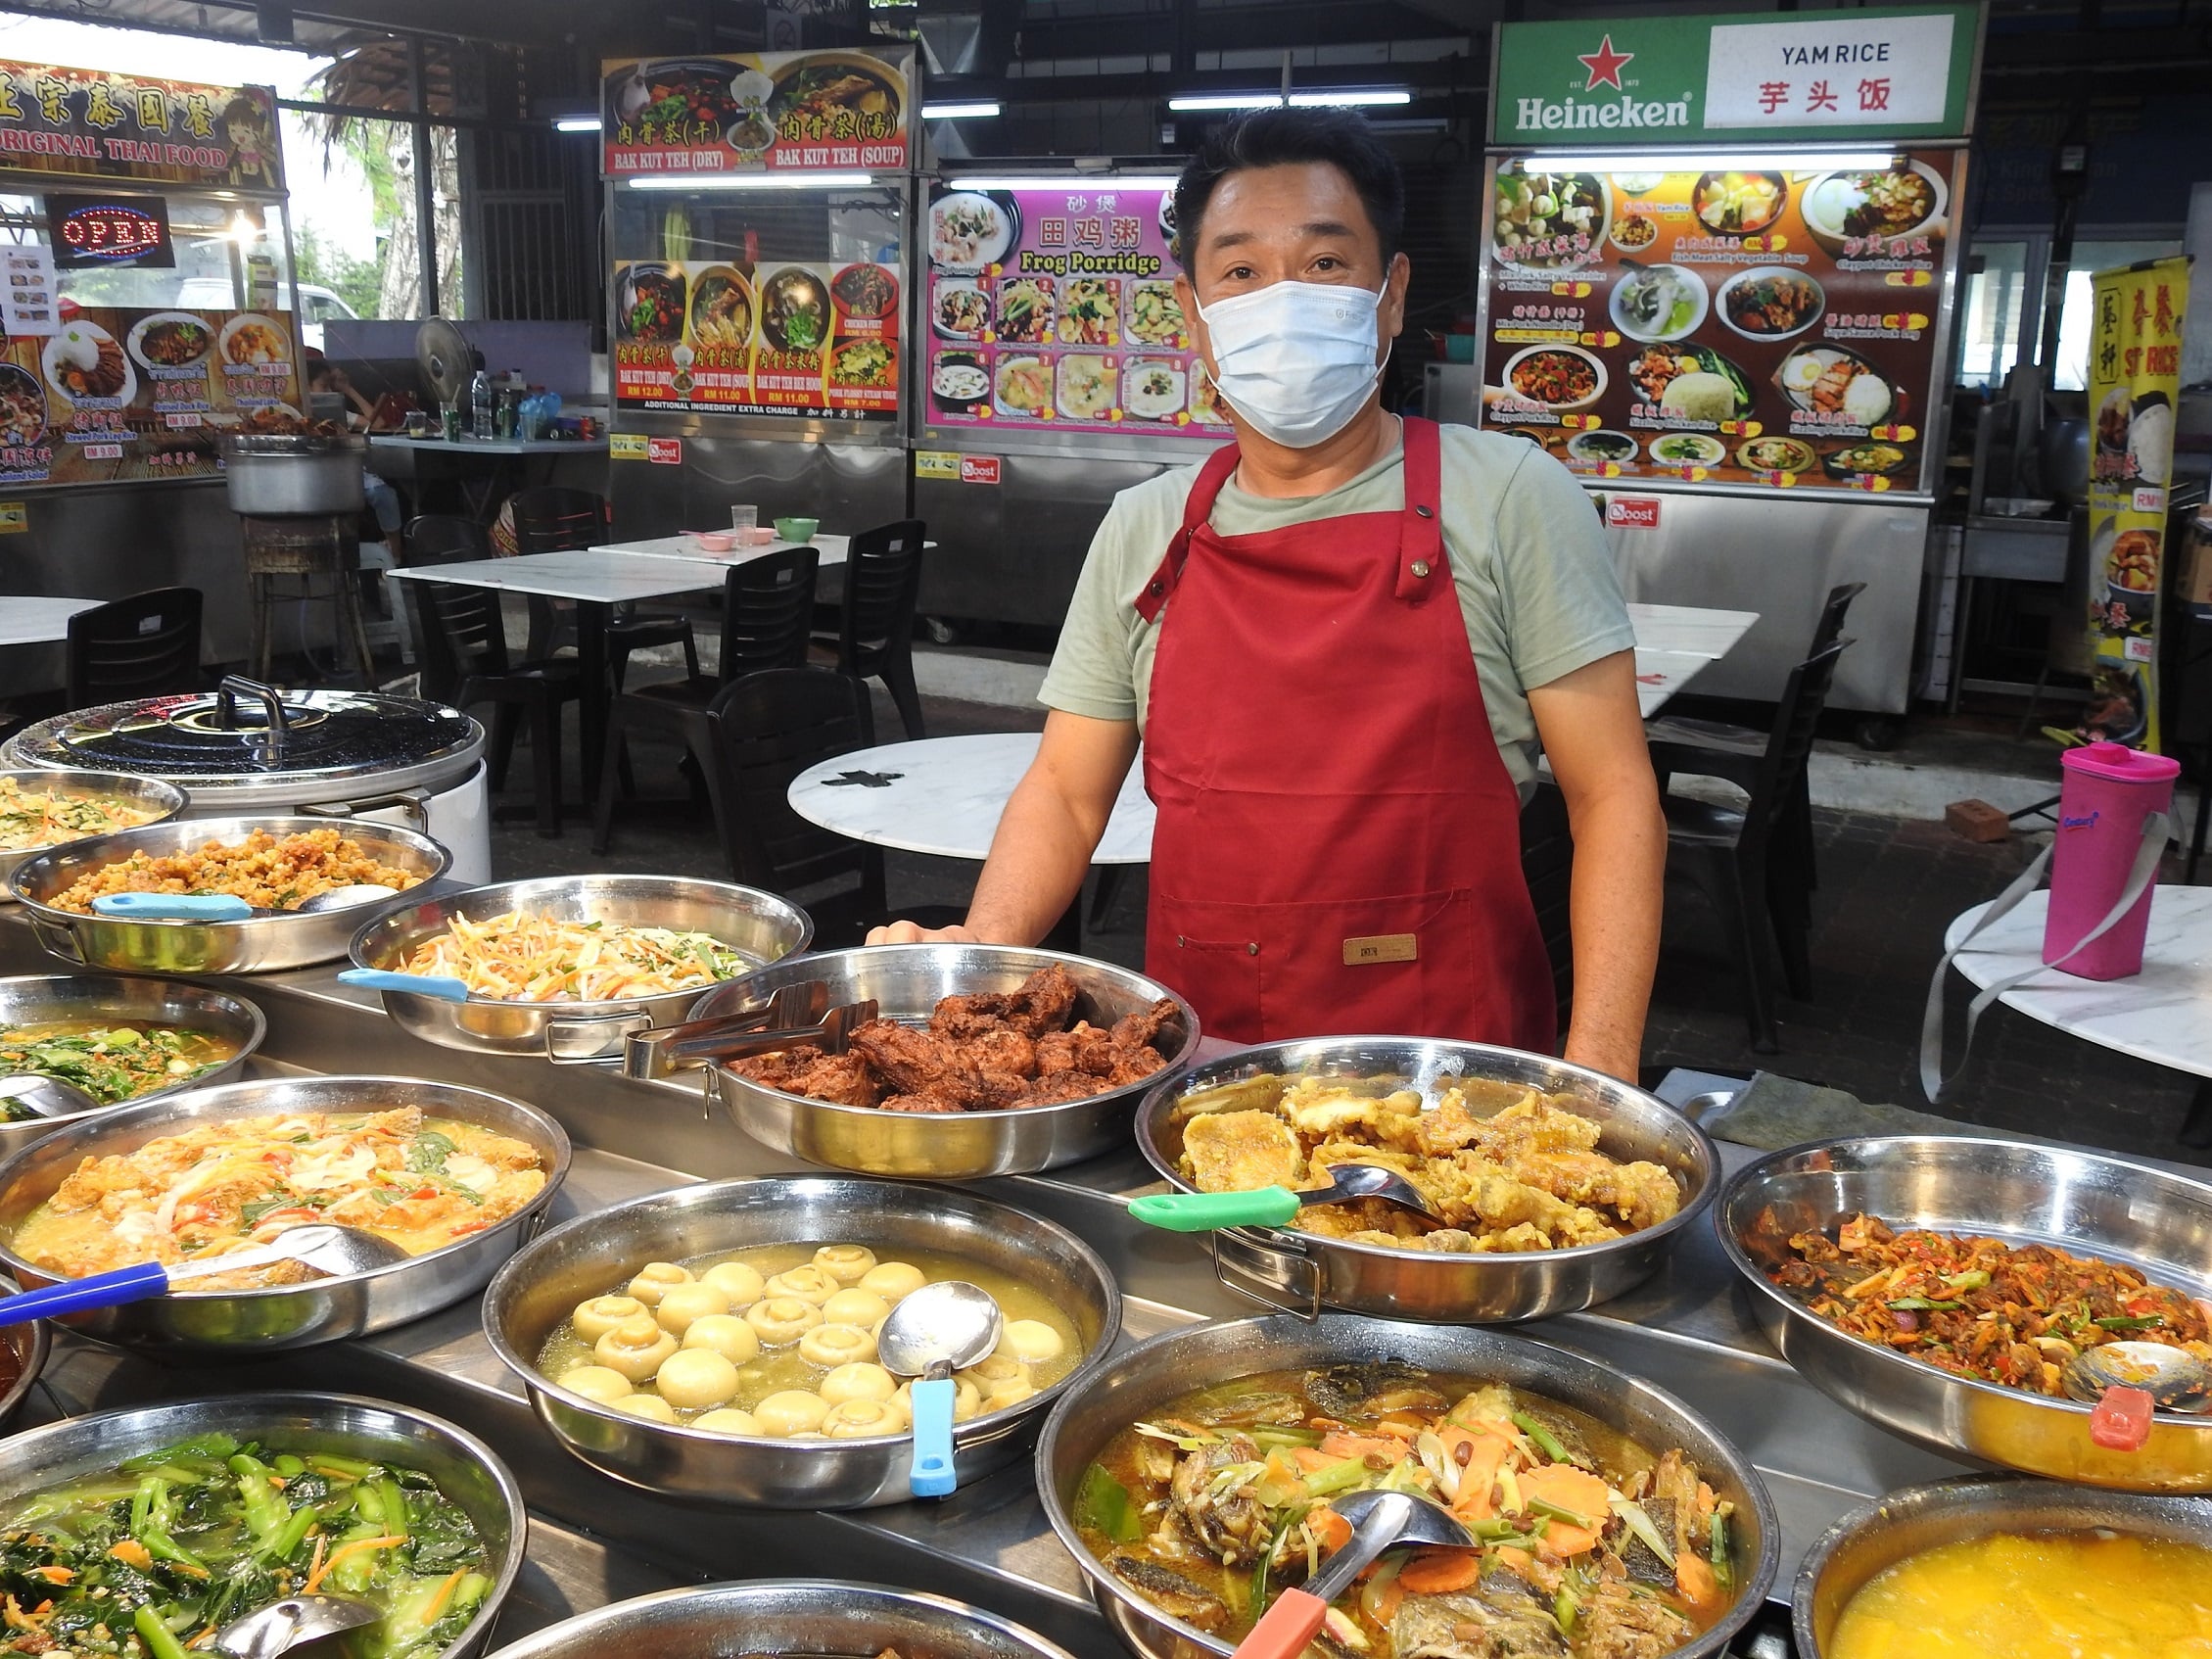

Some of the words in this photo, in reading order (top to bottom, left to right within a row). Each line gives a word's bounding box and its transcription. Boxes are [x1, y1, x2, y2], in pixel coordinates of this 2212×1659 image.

[1782, 44, 1829, 67] YAM
[1835, 43, 1891, 65] RICE
[1759, 77, 1891, 114] 芋头饭
[1516, 96, 1690, 129] Heineken
[105, 138, 162, 165] THAI
[165, 144, 229, 168] FOOD
[615, 153, 637, 169] BAK
[639, 153, 663, 168] KUT
[666, 152, 689, 168] TEH
[692, 151, 724, 171] (DRY)
[776, 149, 801, 166] BAK
[803, 148, 829, 165] KUT
[832, 147, 858, 165] TEH
[861, 146, 904, 167] (SOUP)
[1066, 195, 1116, 213] 砂煲
[63, 220, 159, 245] OPEN
[1040, 217, 1141, 248] 田鸡粥
[1020, 253, 1067, 274] Frog
[1070, 252, 1160, 275] Porridge
[628, 386, 640, 396] RM
[642, 387, 663, 397] 12.00
[704, 390, 717, 400] RM
[720, 391, 740, 401] 11.00
[769, 393, 782, 403] RM
[785, 394, 810, 403] 11.00
[644, 401, 689, 410] ADDITIONAL
[690, 403, 736, 412] INGREDIENT
[738, 404, 764, 414] EXTRA
[766, 405, 798, 415] CHARGE
